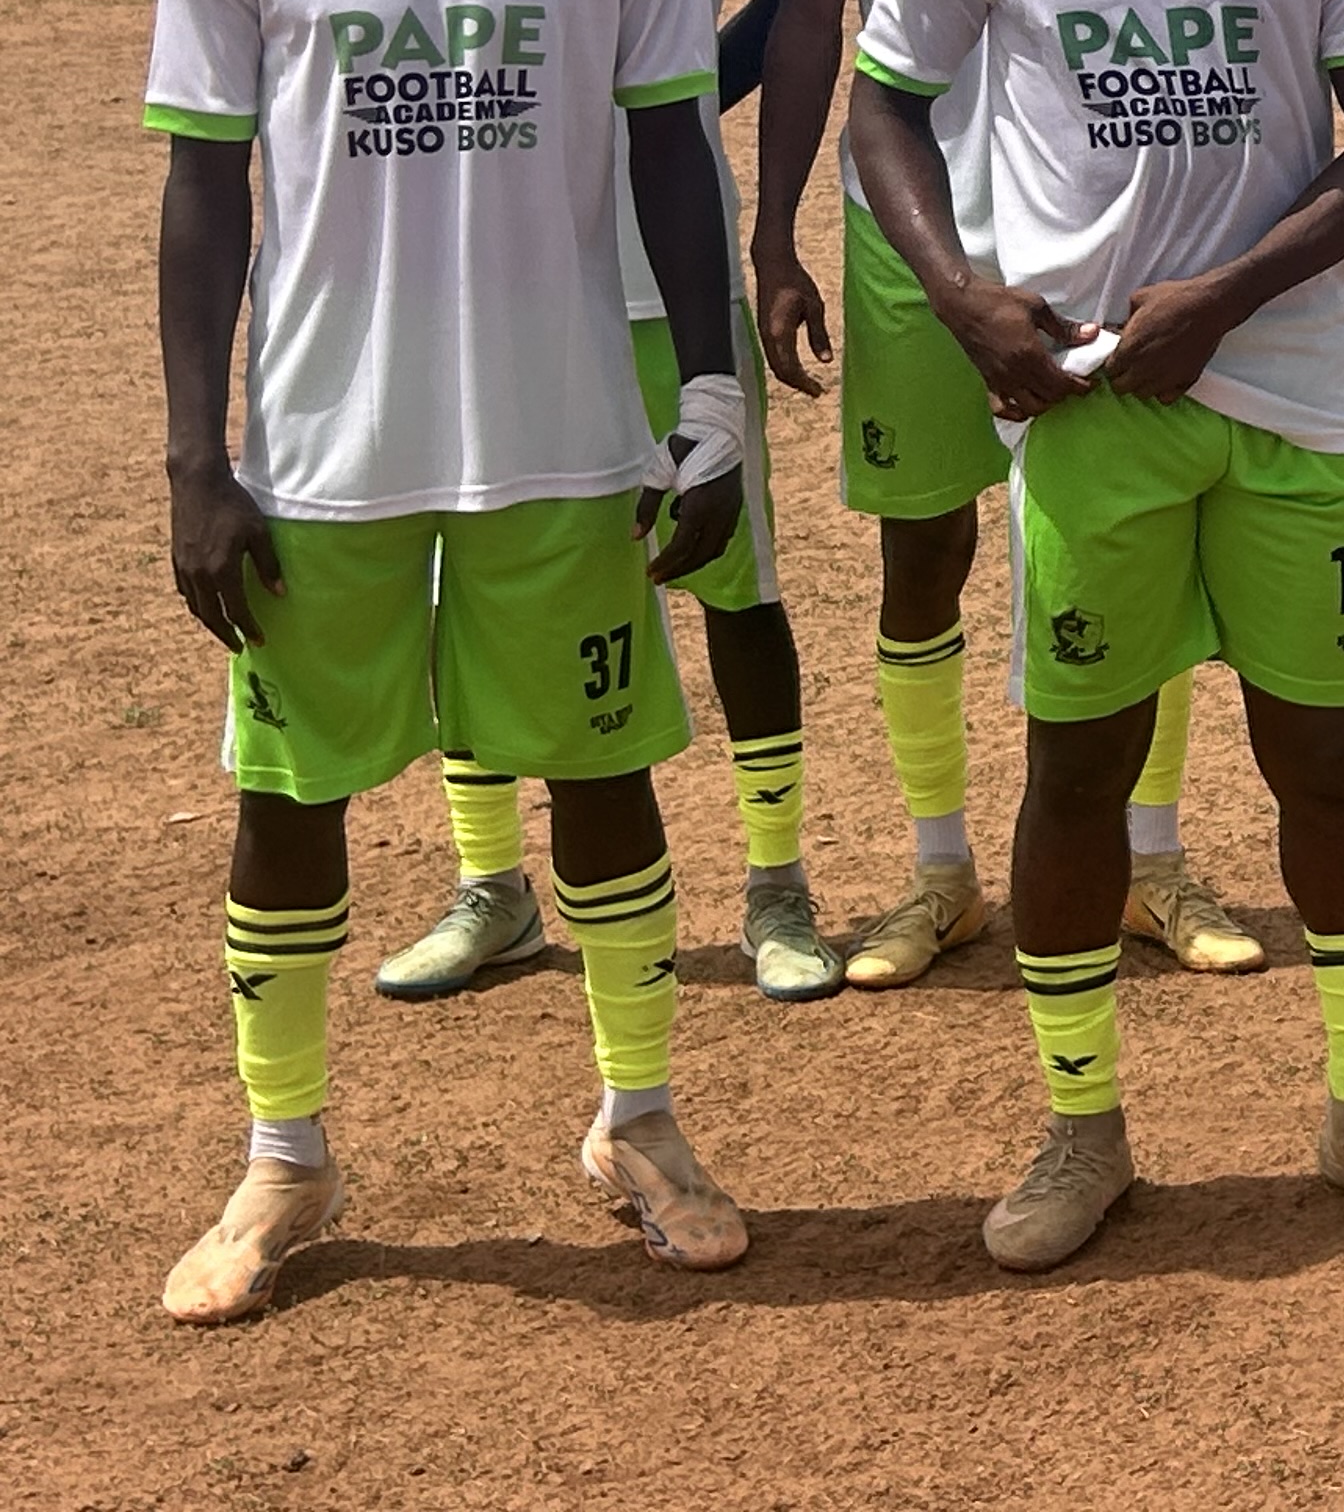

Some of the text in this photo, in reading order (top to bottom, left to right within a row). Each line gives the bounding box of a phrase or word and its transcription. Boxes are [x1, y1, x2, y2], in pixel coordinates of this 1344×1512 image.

[329, 4, 546, 75] PAPE
[1056, 6, 1260, 71] PAPE
[344, 69, 537, 106] FOOTBALL
[1077, 67, 1256, 100] FOOTBALL
[375, 100, 514, 125] ACADEMY
[1110, 96, 1245, 118] ACADEMY
[348, 122, 538, 157] KUSO BOYS
[1088, 119, 1262, 149] KUSO BOYS
[579, 621, 633, 699] 37
